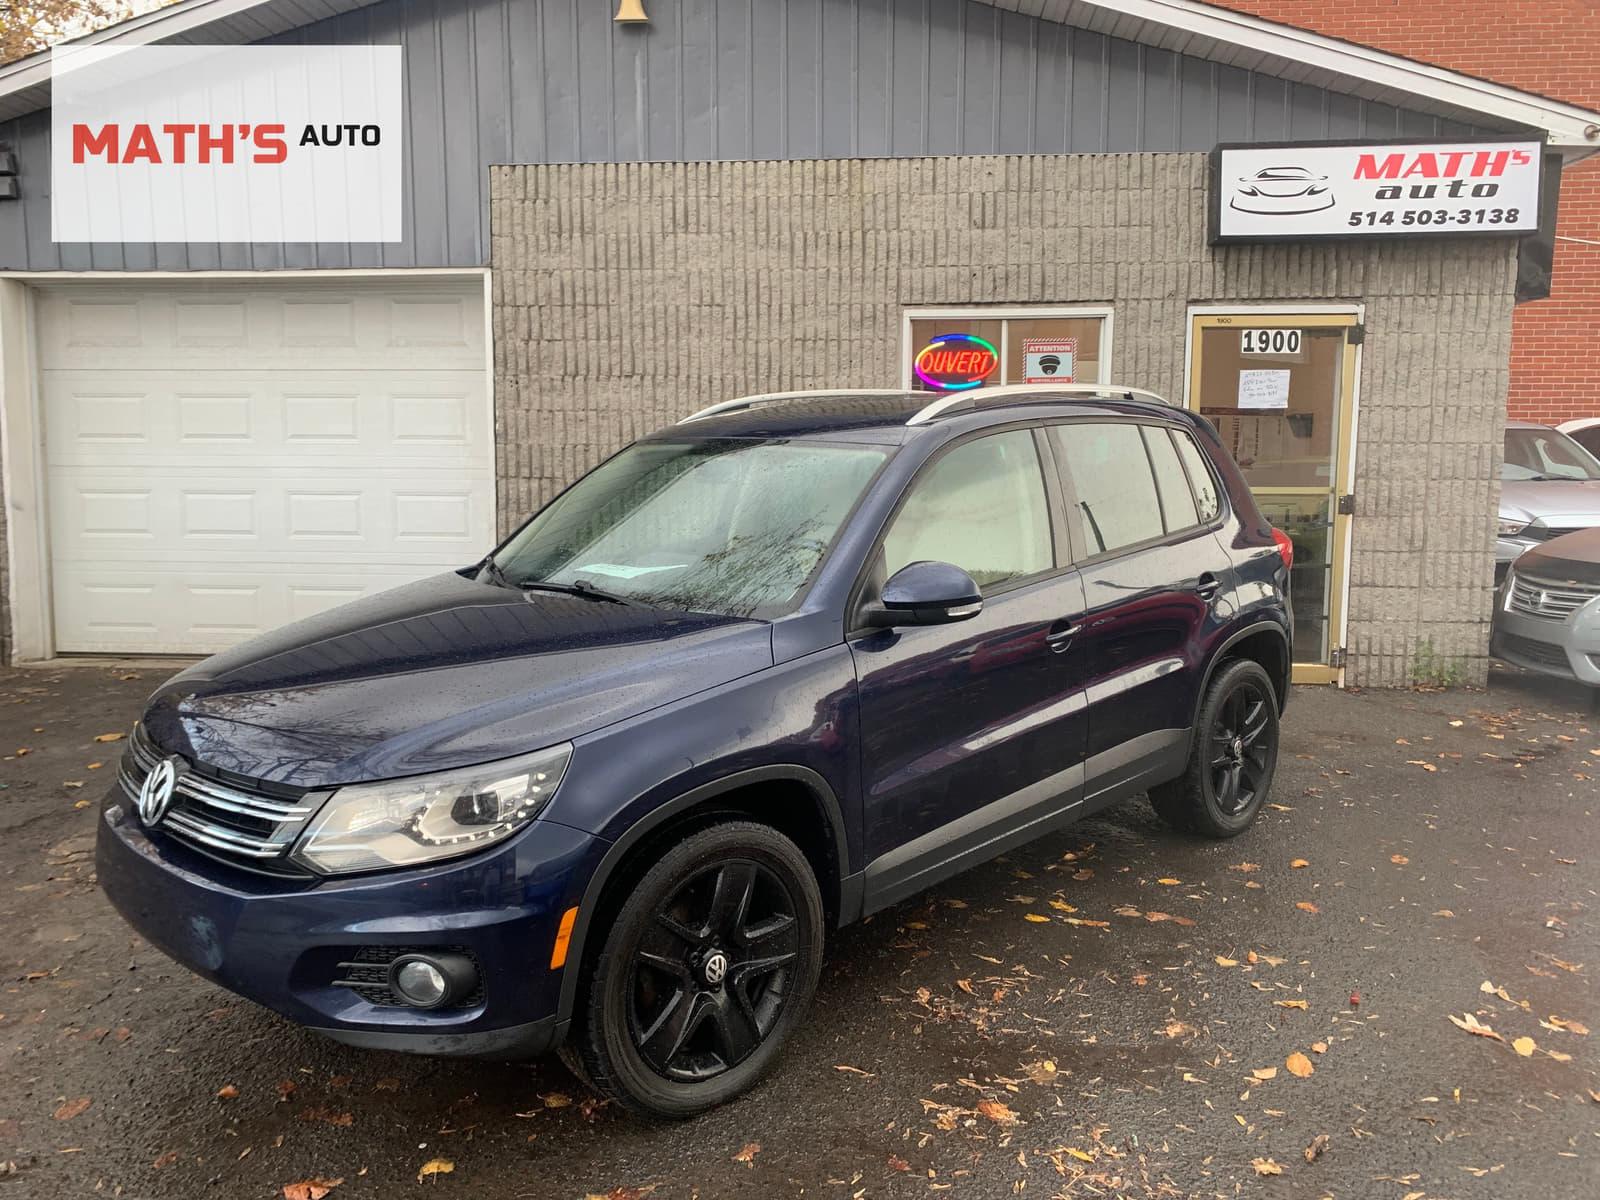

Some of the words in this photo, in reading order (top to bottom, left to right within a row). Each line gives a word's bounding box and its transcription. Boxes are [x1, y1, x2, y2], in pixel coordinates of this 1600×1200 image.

[1375, 180, 1499, 200] auto
[1348, 211, 1395, 226] 514
[1401, 208, 1520, 225] 503-3138
[1243, 330, 1299, 352] 1900
[919, 351, 993, 374] OUVERT
